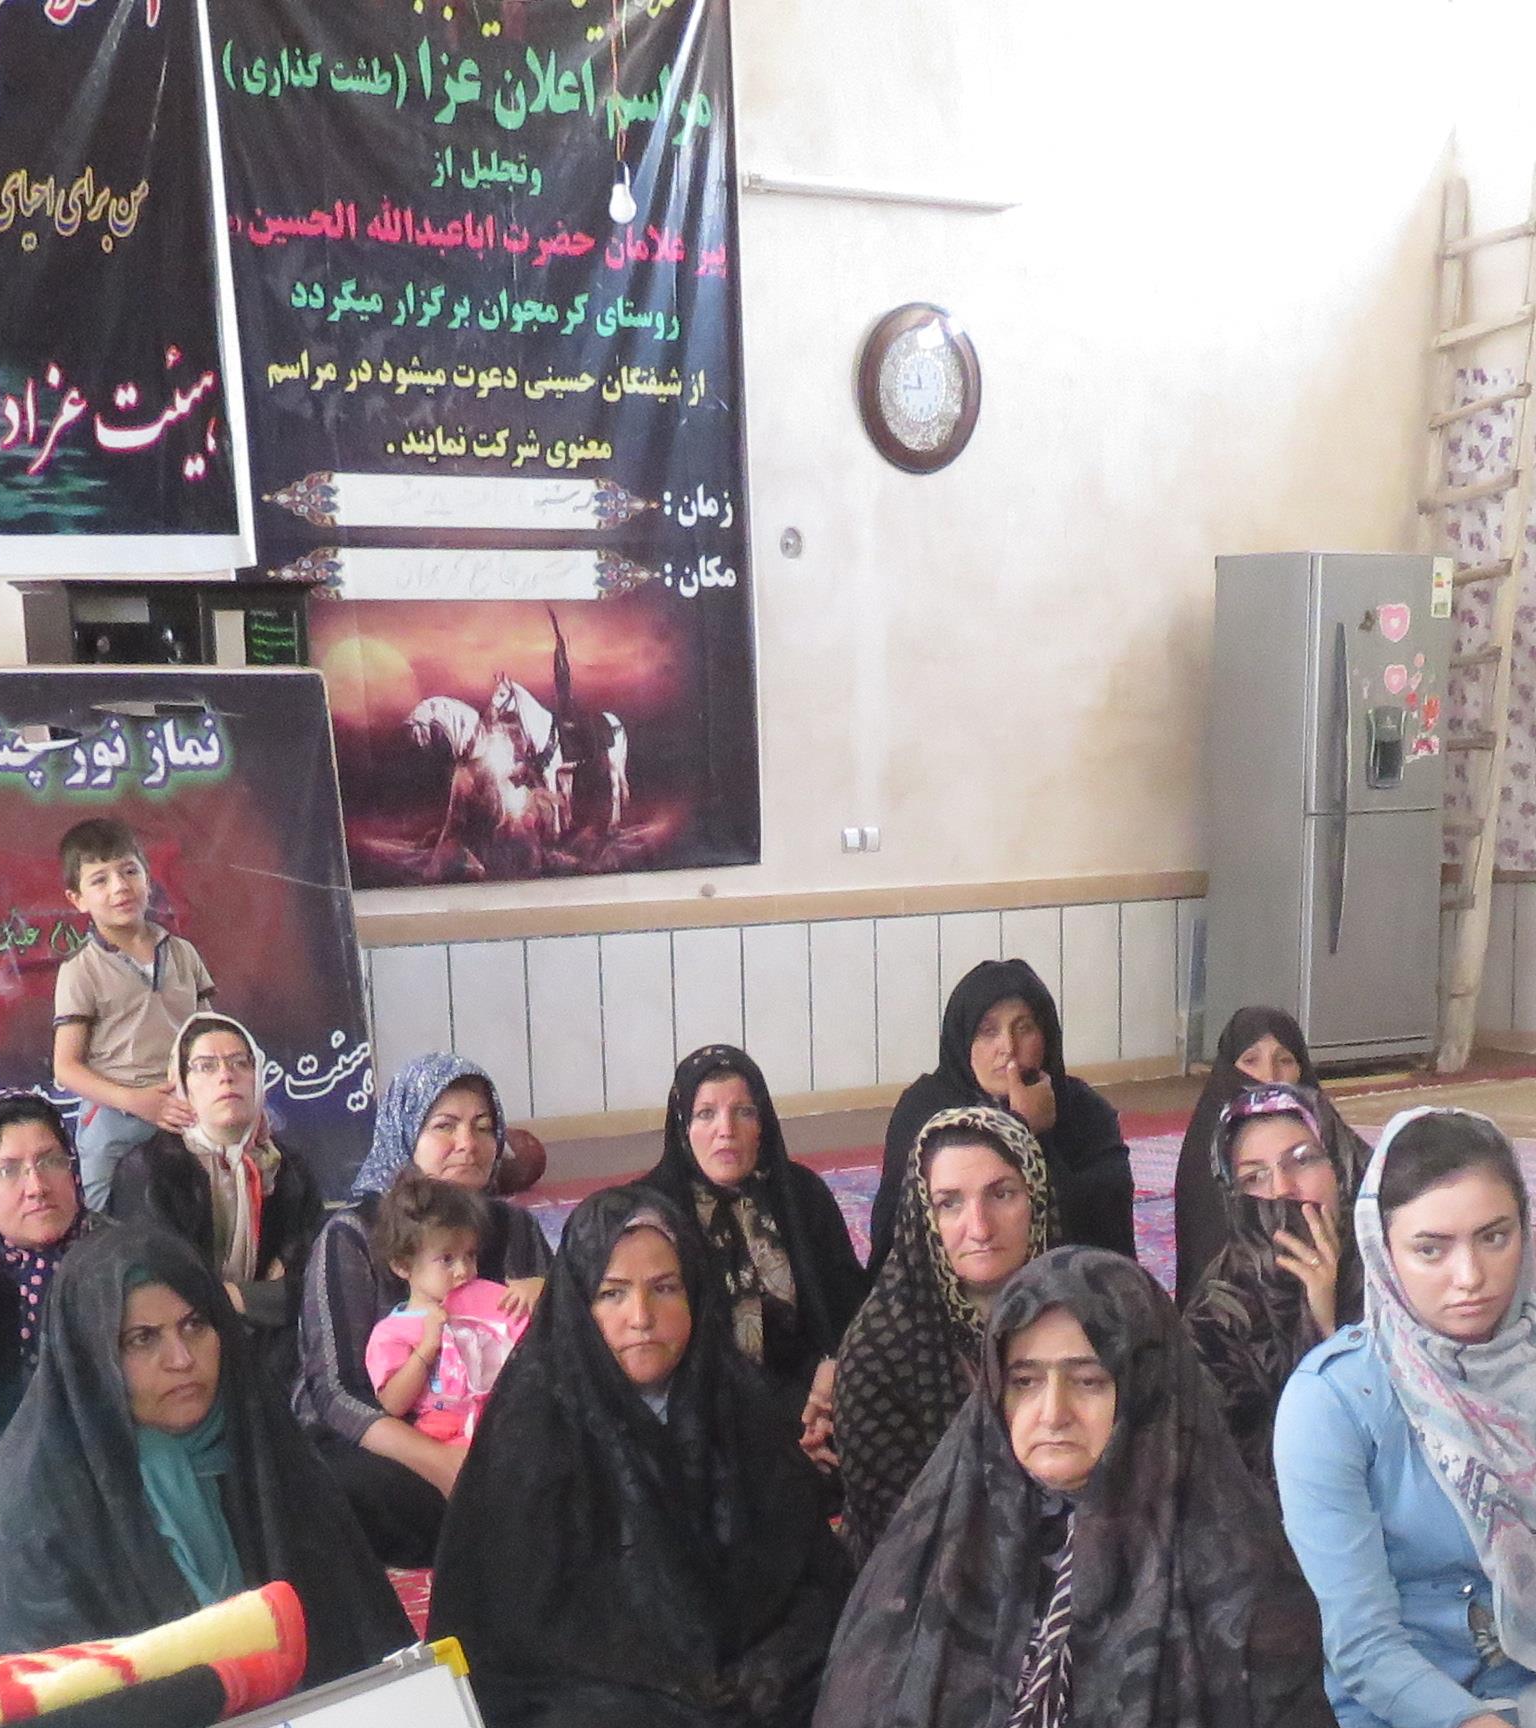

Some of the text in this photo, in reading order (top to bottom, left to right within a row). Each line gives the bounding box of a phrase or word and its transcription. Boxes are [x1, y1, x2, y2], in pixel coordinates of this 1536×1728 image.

[418, 35, 482, 125] عزا
[494, 46, 596, 130] اعلان
[430, 145, 454, 187] از
[54, 166, 112, 254] برای
[108, 178, 150, 238] من
[247, 198, 358, 246] الحسین
[503, 220, 597, 268] حضرت
[392, 279, 471, 330] برگزار
[596, 296, 681, 341] روستای
[267, 349, 338, 391] مراسم
[345, 356, 373, 393] در
[453, 361, 518, 400] دعوت
[524, 366, 597, 402] حسینی
[602, 358, 683, 403] شیفتگان
[687, 369, 706, 409] از
[401, 424, 613, 469] معنوی شرکت نمایند
[65, 719, 127, 786] نور
[142, 718, 223, 787] نماز
